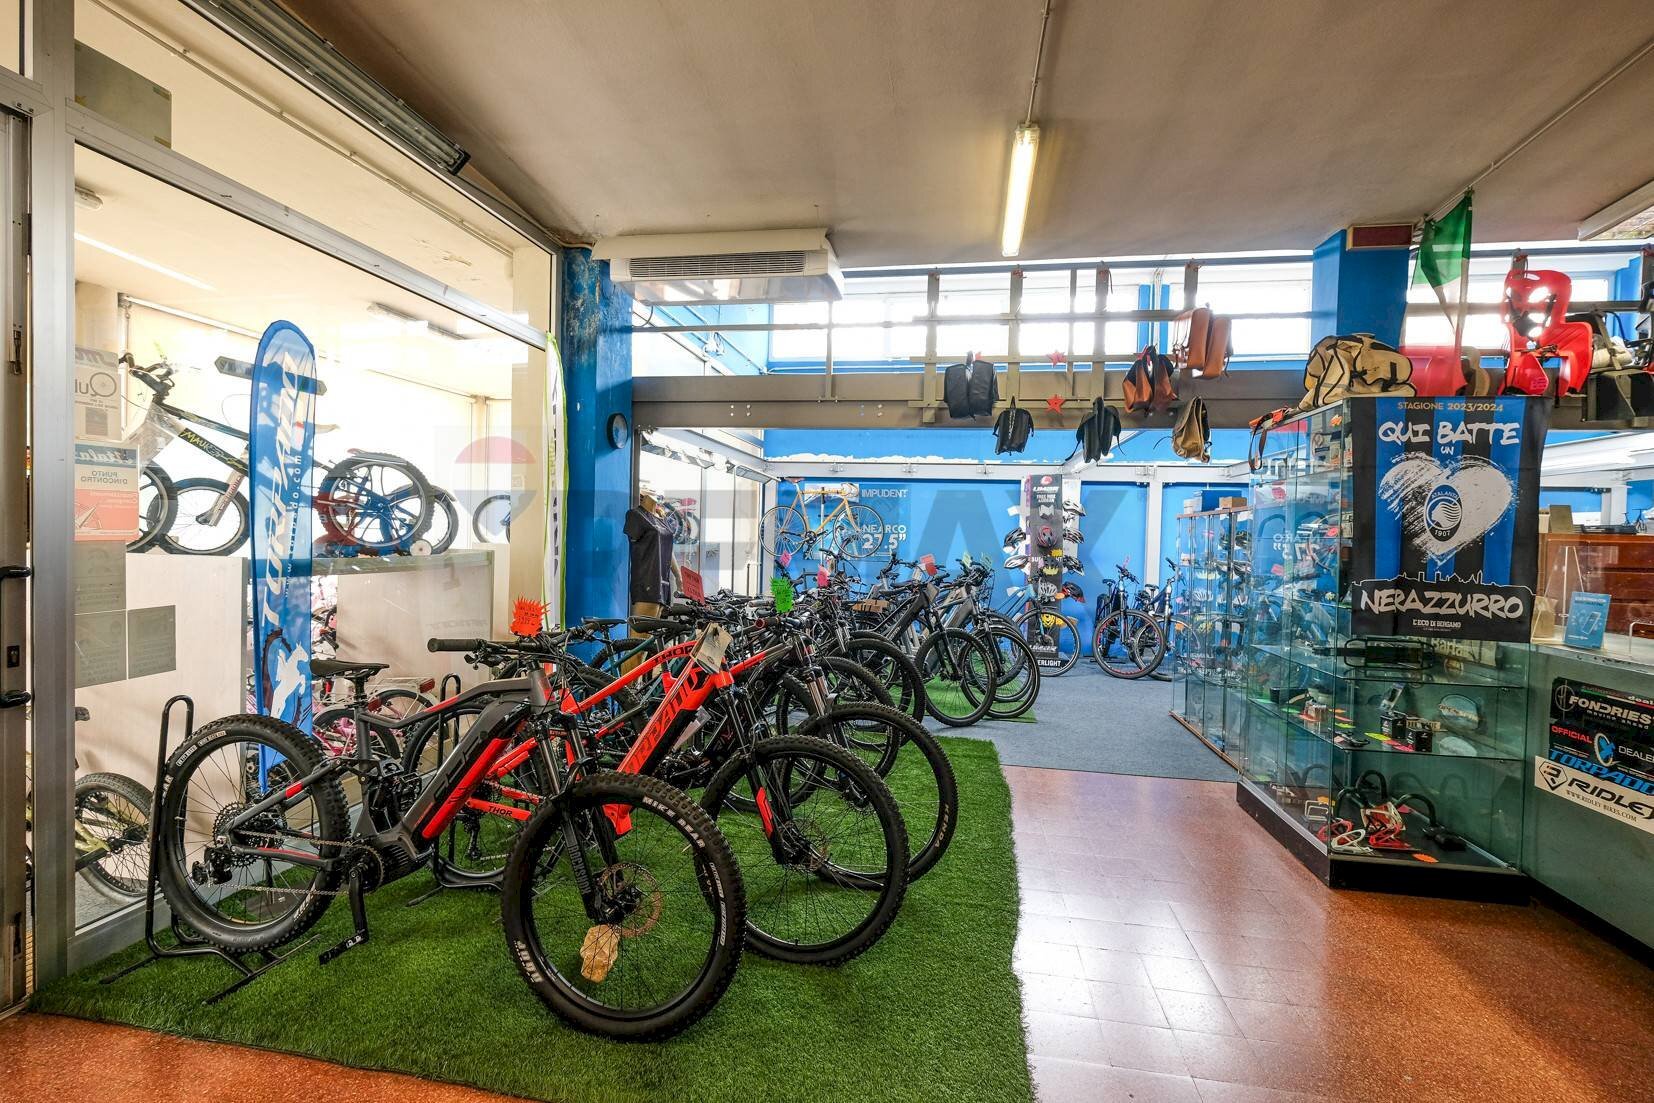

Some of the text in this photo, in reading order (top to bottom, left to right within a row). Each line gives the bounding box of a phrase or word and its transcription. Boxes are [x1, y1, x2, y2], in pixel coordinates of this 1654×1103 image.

[1397, 401, 1503, 412] STAGIONE 2023/2024
[1378, 421, 1521, 446] QUI BATTE
[1440, 446, 1454, 455] UN
[262, 352, 298, 627] TORPADO
[861, 488, 909, 498] IMPUDENT
[862, 524, 907, 533] NEARCO
[1434, 529, 1451, 537] 1907
[1360, 588, 1524, 619] NERAZZURRO
[1568, 695, 1654, 725] FONDRIES
[1551, 725, 1654, 763] OFFICIAL DEALE
[488, 805, 513, 817] THOR
[934, 803, 949, 847] KENDA
